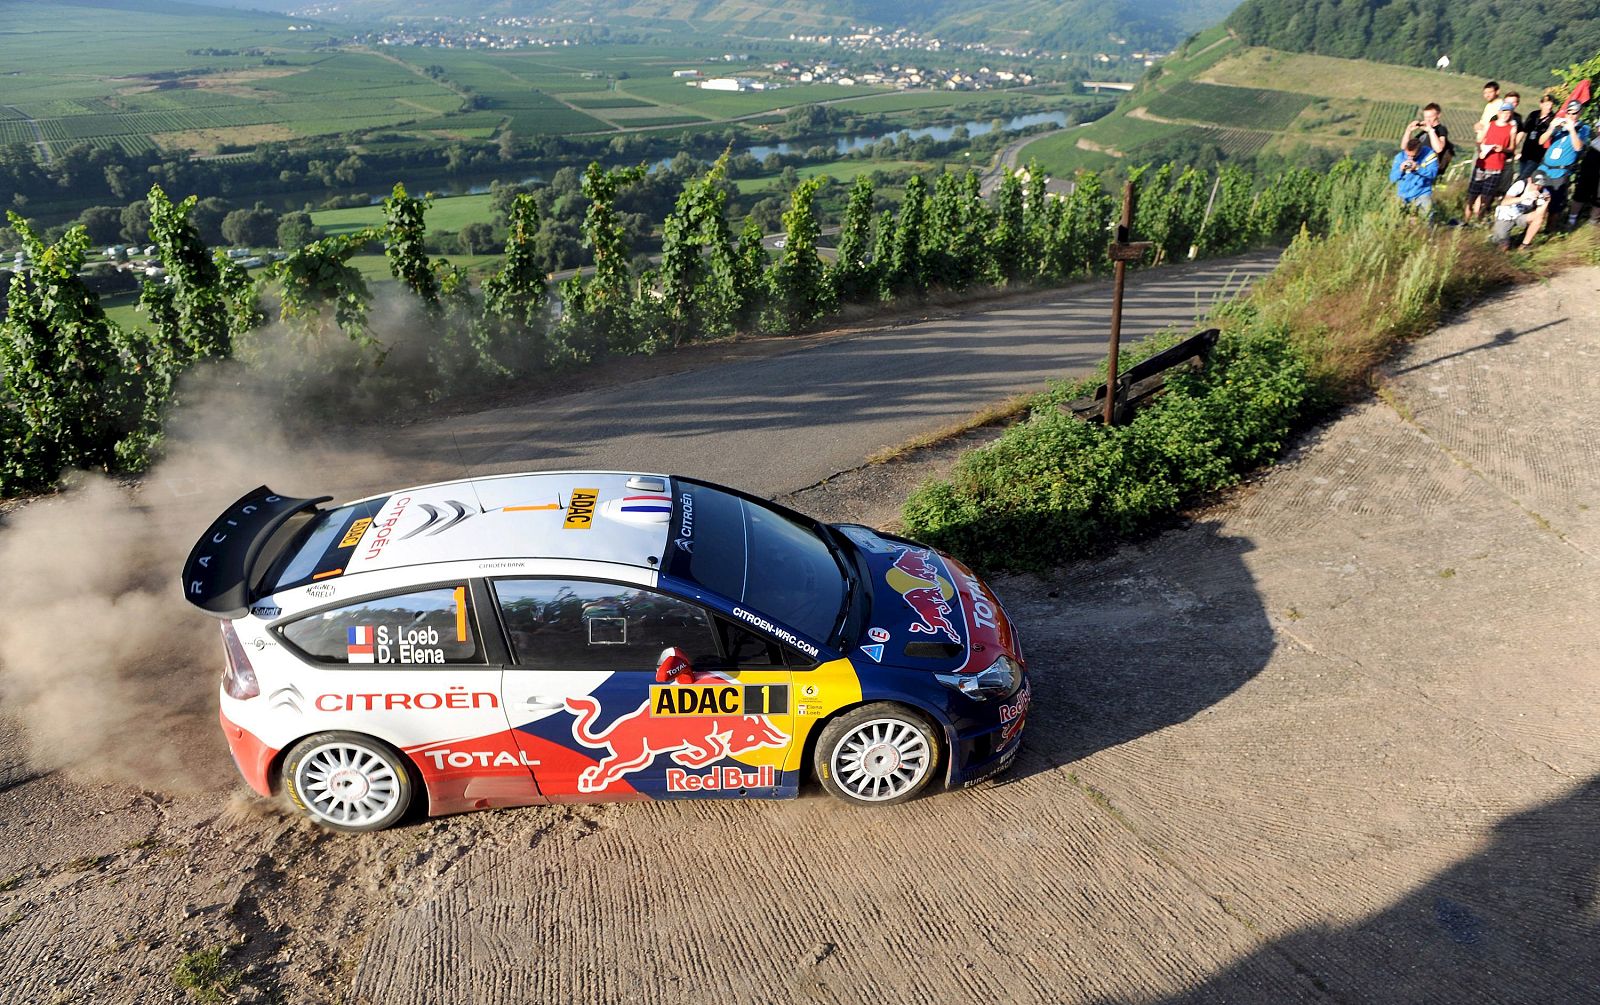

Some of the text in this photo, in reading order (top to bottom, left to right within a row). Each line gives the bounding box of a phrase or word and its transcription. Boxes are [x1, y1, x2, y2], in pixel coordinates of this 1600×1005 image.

[566, 493, 596, 523] ADAC
[453, 586, 467, 642] 1
[961, 573, 996, 629] TOTAL
[377, 625, 439, 645] S. Loeb
[732, 607, 819, 657] CITROEN-WRC.COM
[872, 630, 887, 640] E
[378, 645, 445, 664] D. Elena
[666, 663, 687, 676] TOTAL
[656, 685, 769, 714] ADAC 1
[806, 686, 814, 695] 6
[999, 690, 1026, 724] Red
[424, 750, 541, 770] TOTAL
[666, 765, 774, 791] Red Bull
